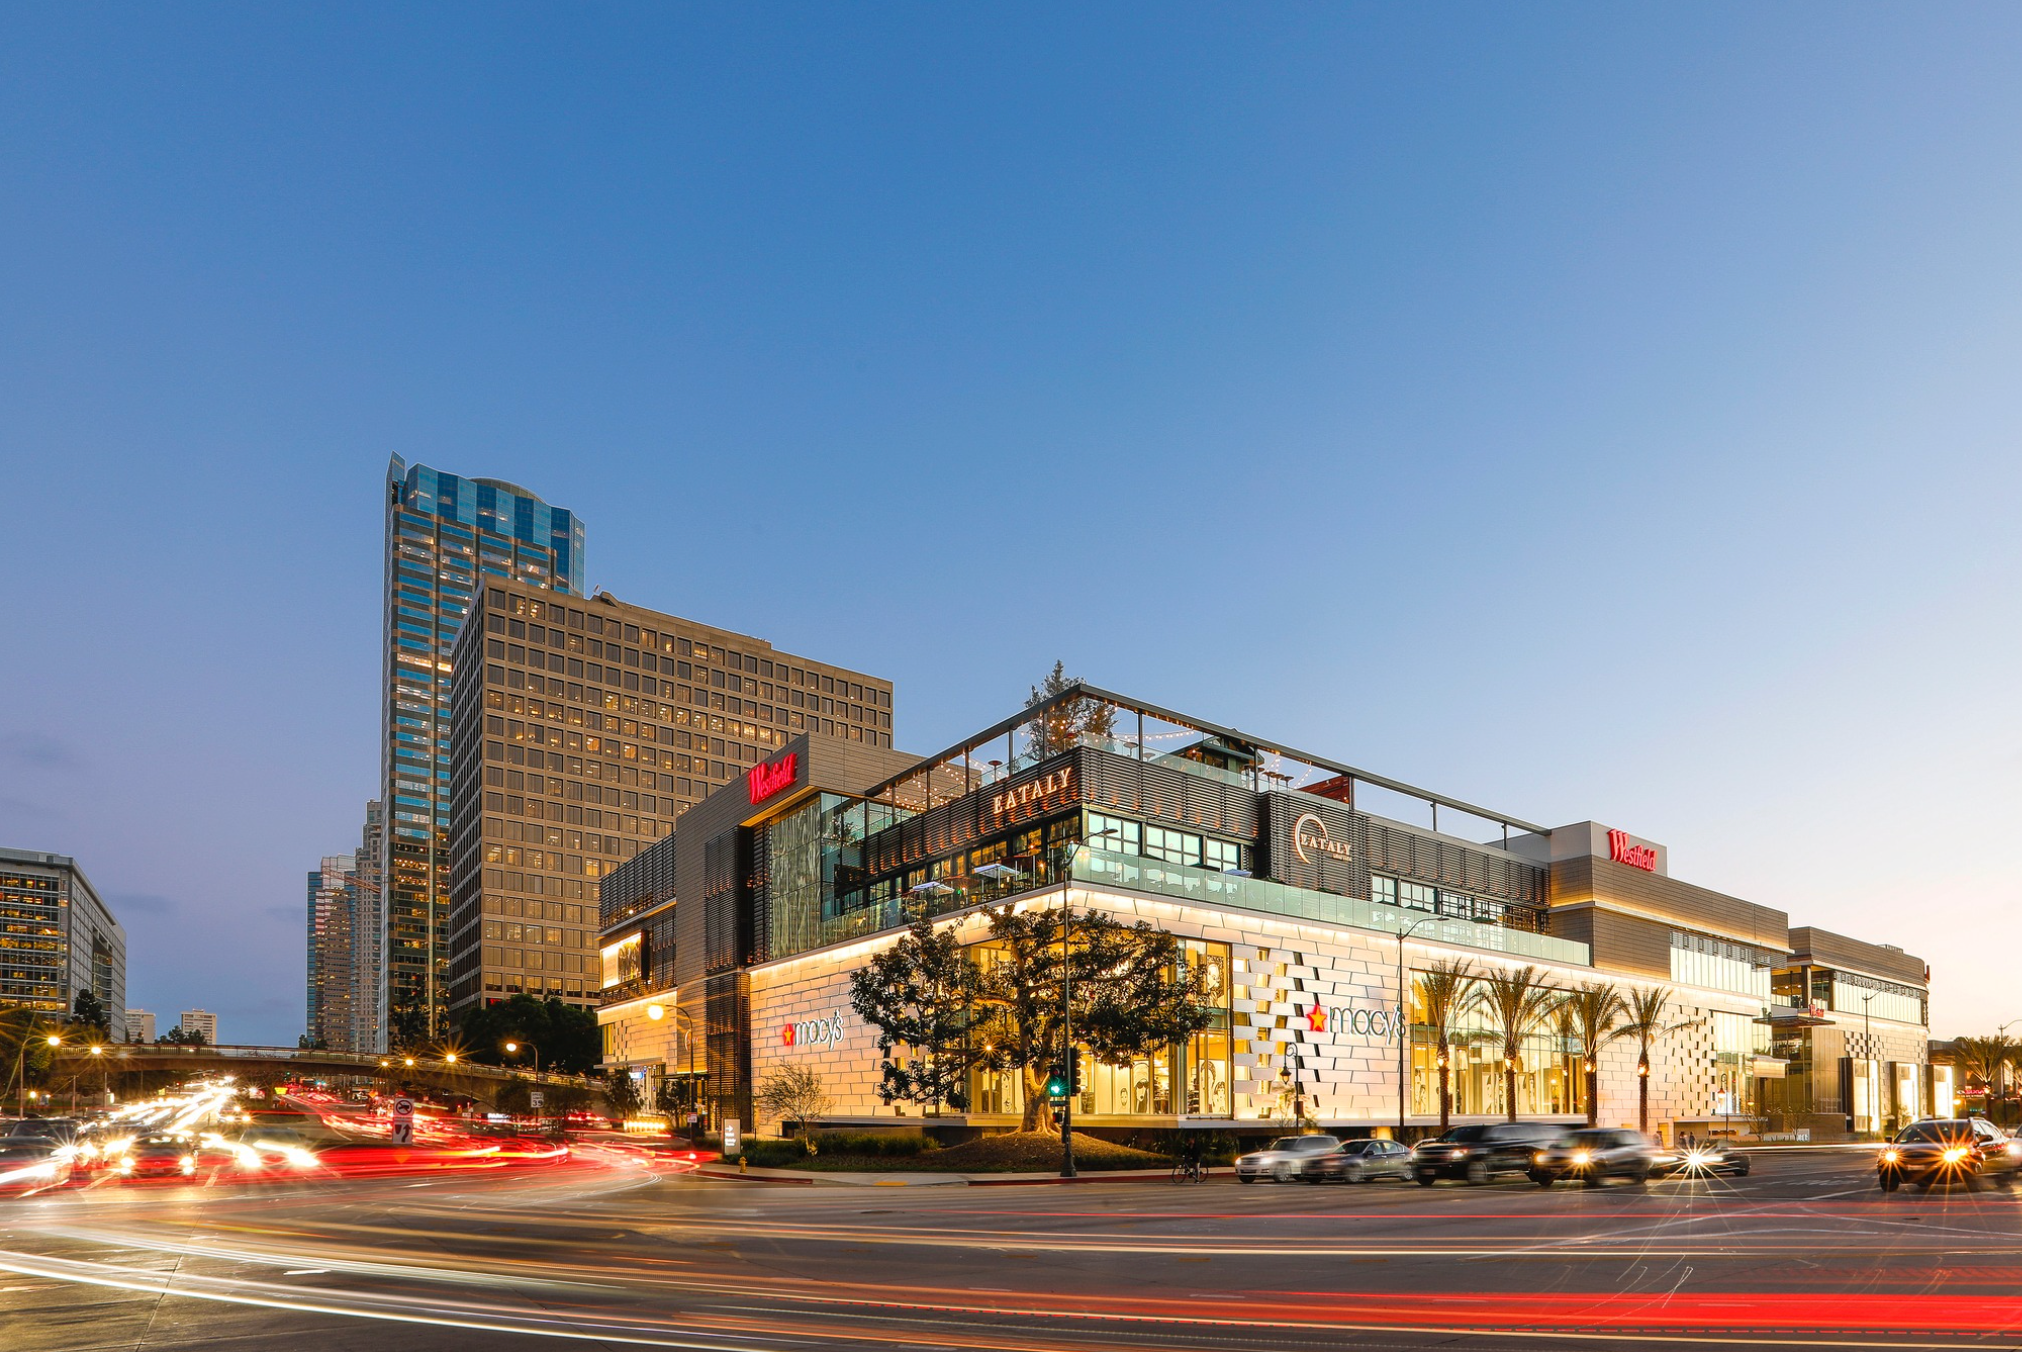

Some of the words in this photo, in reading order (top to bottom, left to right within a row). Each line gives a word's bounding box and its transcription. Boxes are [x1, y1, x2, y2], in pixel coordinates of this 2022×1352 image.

[748, 752, 797, 805] Westfield
[992, 767, 1072, 815] EATALY
[1300, 833, 1351, 856] EATALY
[1607, 829, 1658, 872] Westfield
[794, 1009, 844, 1051] macy's
[1328, 1004, 1406, 1046] macy's
